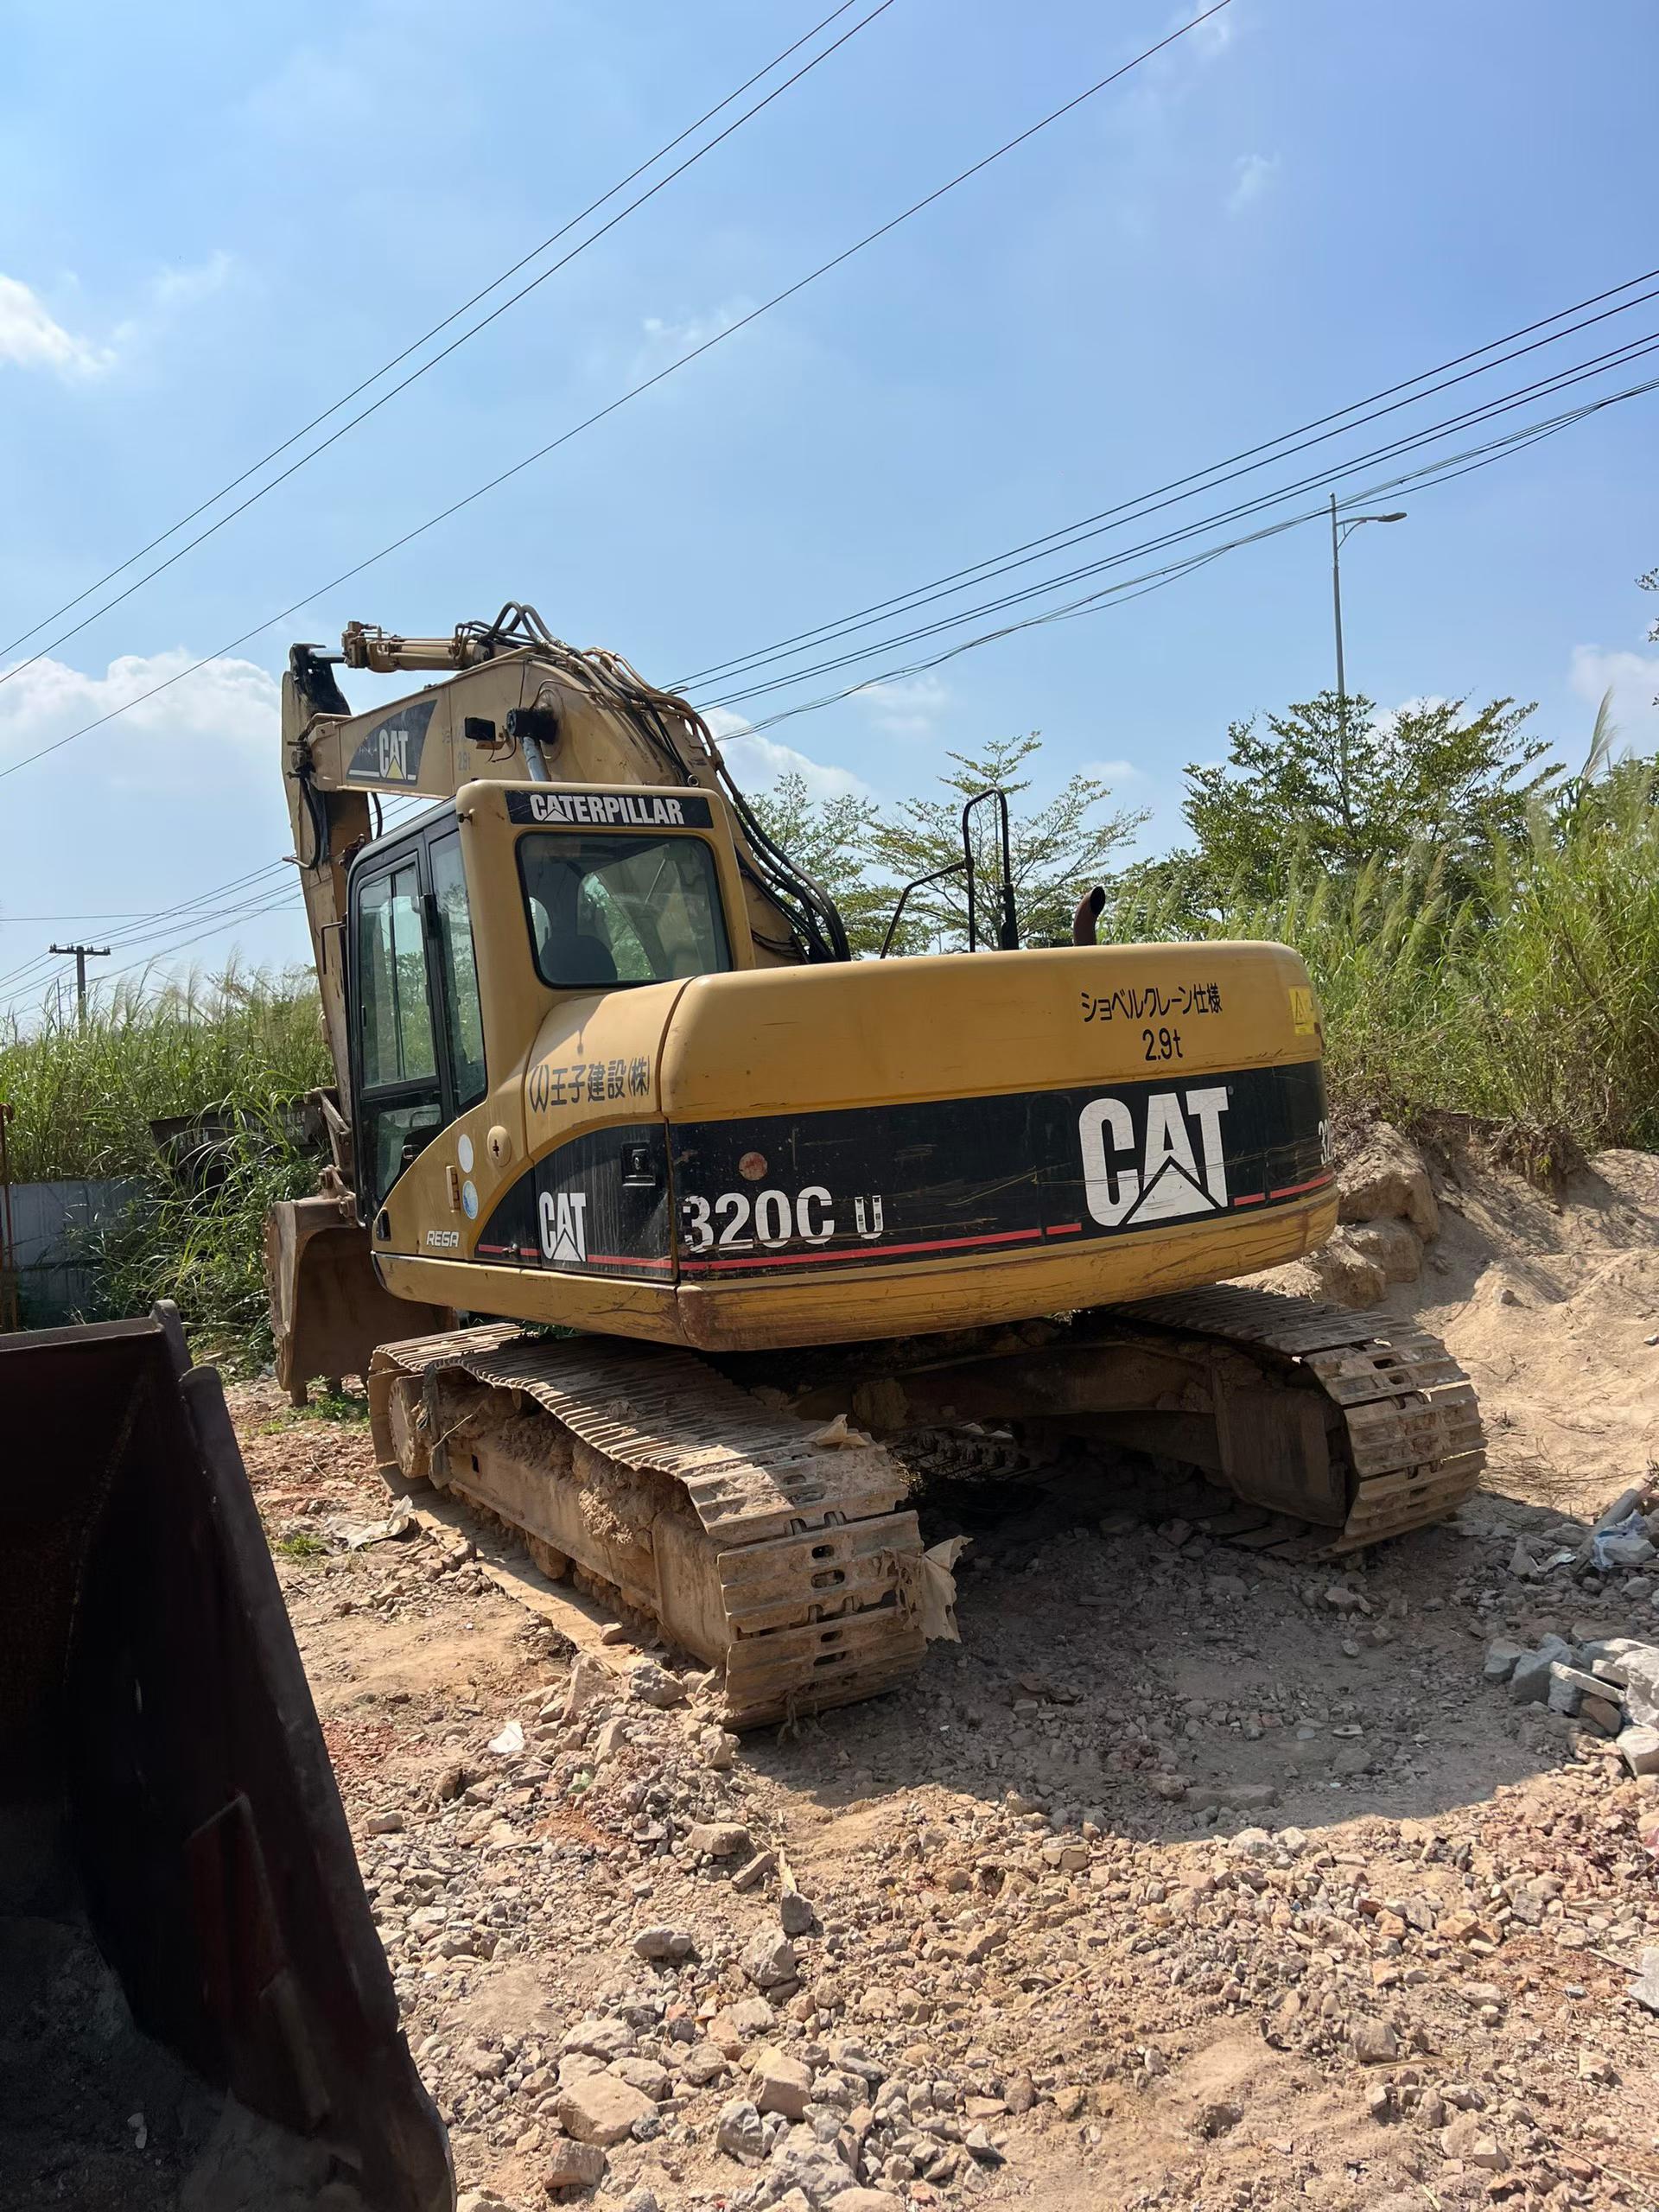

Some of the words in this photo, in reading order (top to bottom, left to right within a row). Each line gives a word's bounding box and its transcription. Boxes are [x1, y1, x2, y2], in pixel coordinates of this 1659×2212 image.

[379, 728, 409, 780] CAT
[530, 794, 685, 824] CATERPILLAR
[1081, 982, 1223, 1022] ショベルクレーン仕様
[1142, 1027, 1183, 1061] 2.9t
[1078, 1086, 1230, 1227] CAT
[426, 1230, 460, 1248] REGA
[539, 1192, 587, 1262] CAT
[683, 1185, 835, 1253] 320C
[855, 1194, 884, 1239] U
